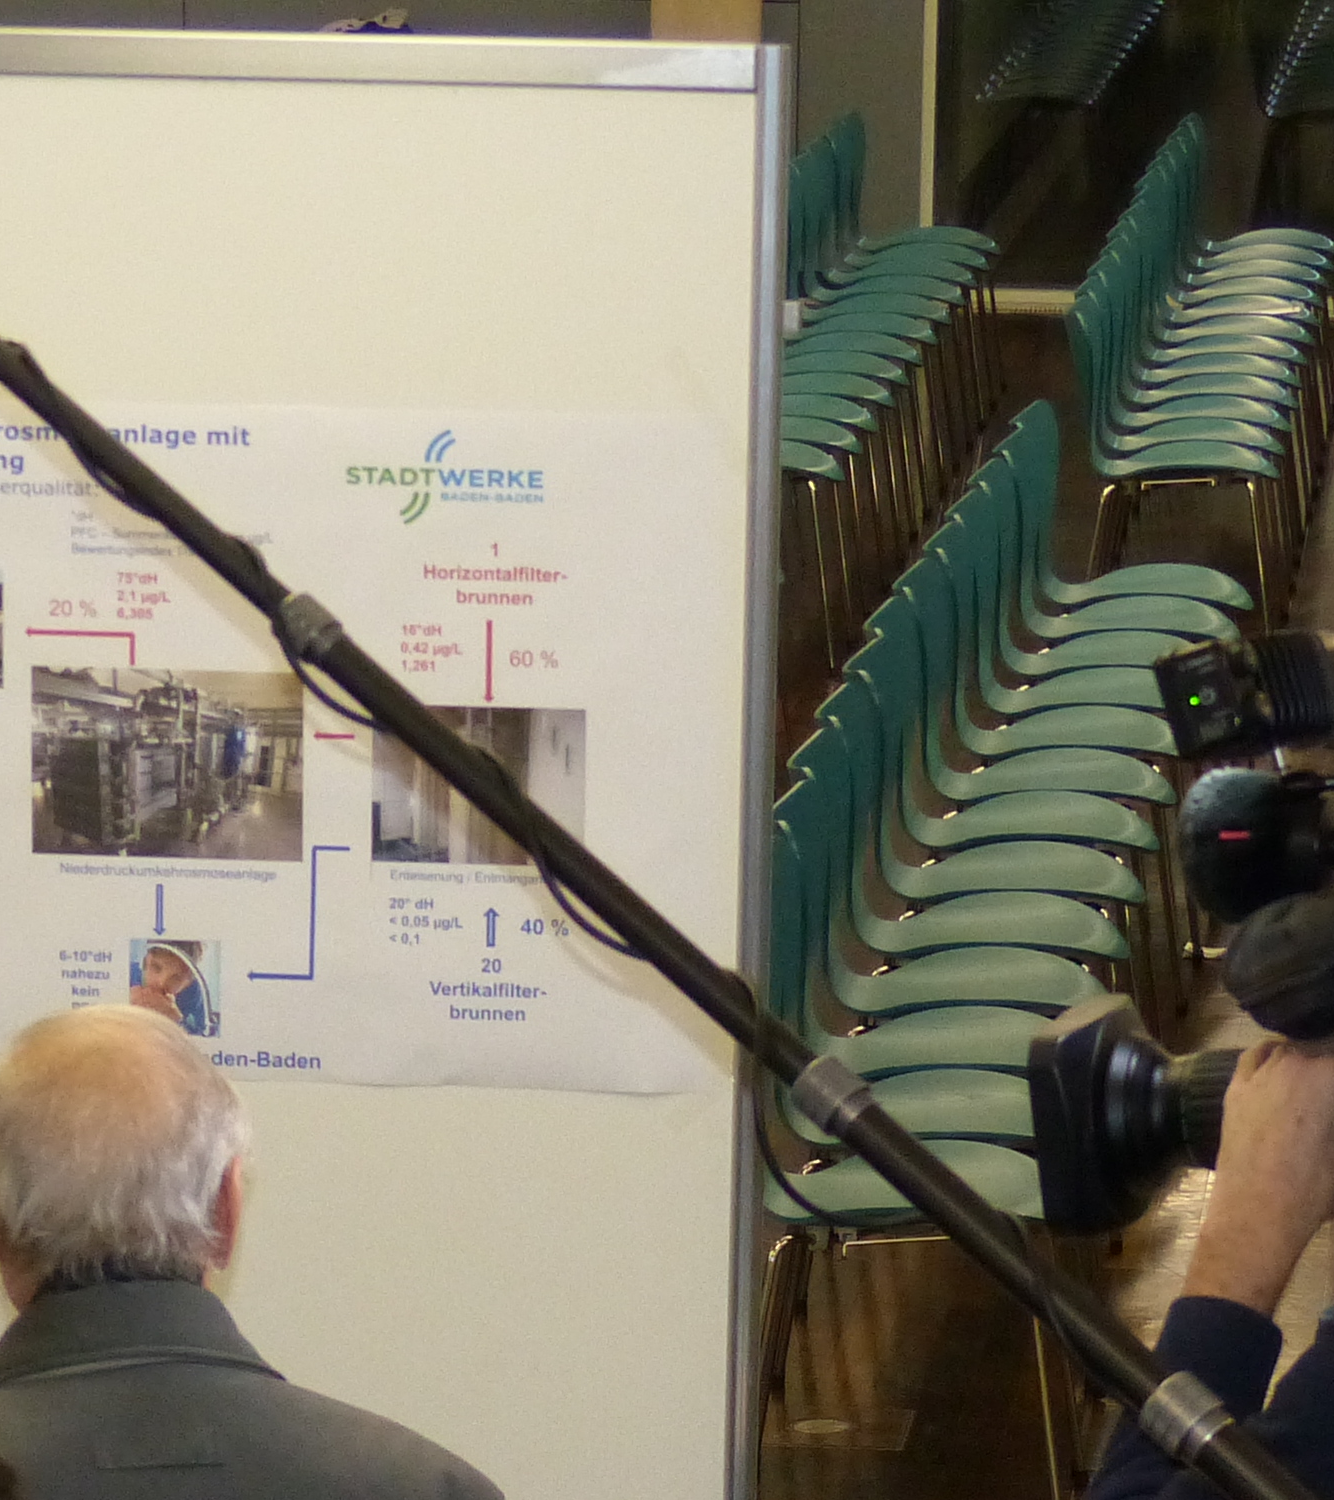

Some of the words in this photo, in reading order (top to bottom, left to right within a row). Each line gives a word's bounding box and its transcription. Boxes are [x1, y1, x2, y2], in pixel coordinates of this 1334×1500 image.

[207, 426, 251, 446] mit
[346, 465, 544, 489] STADTWERKE
[490, 543, 499, 558] 1
[423, 563, 569, 583] Horizontalfilter-
[456, 589, 534, 606] brunnen
[49, 600, 73, 617] 20
[79, 601, 98, 618] %
[509, 650, 534, 668] 60
[541, 651, 560, 669] %
[520, 918, 544, 936] 40
[550, 918, 570, 937] %
[481, 957, 503, 974] 20
[429, 980, 548, 1000] Vertikalfilter-
[449, 1004, 527, 1022] brunnen
[209, 1051, 322, 1070] den-Baden
